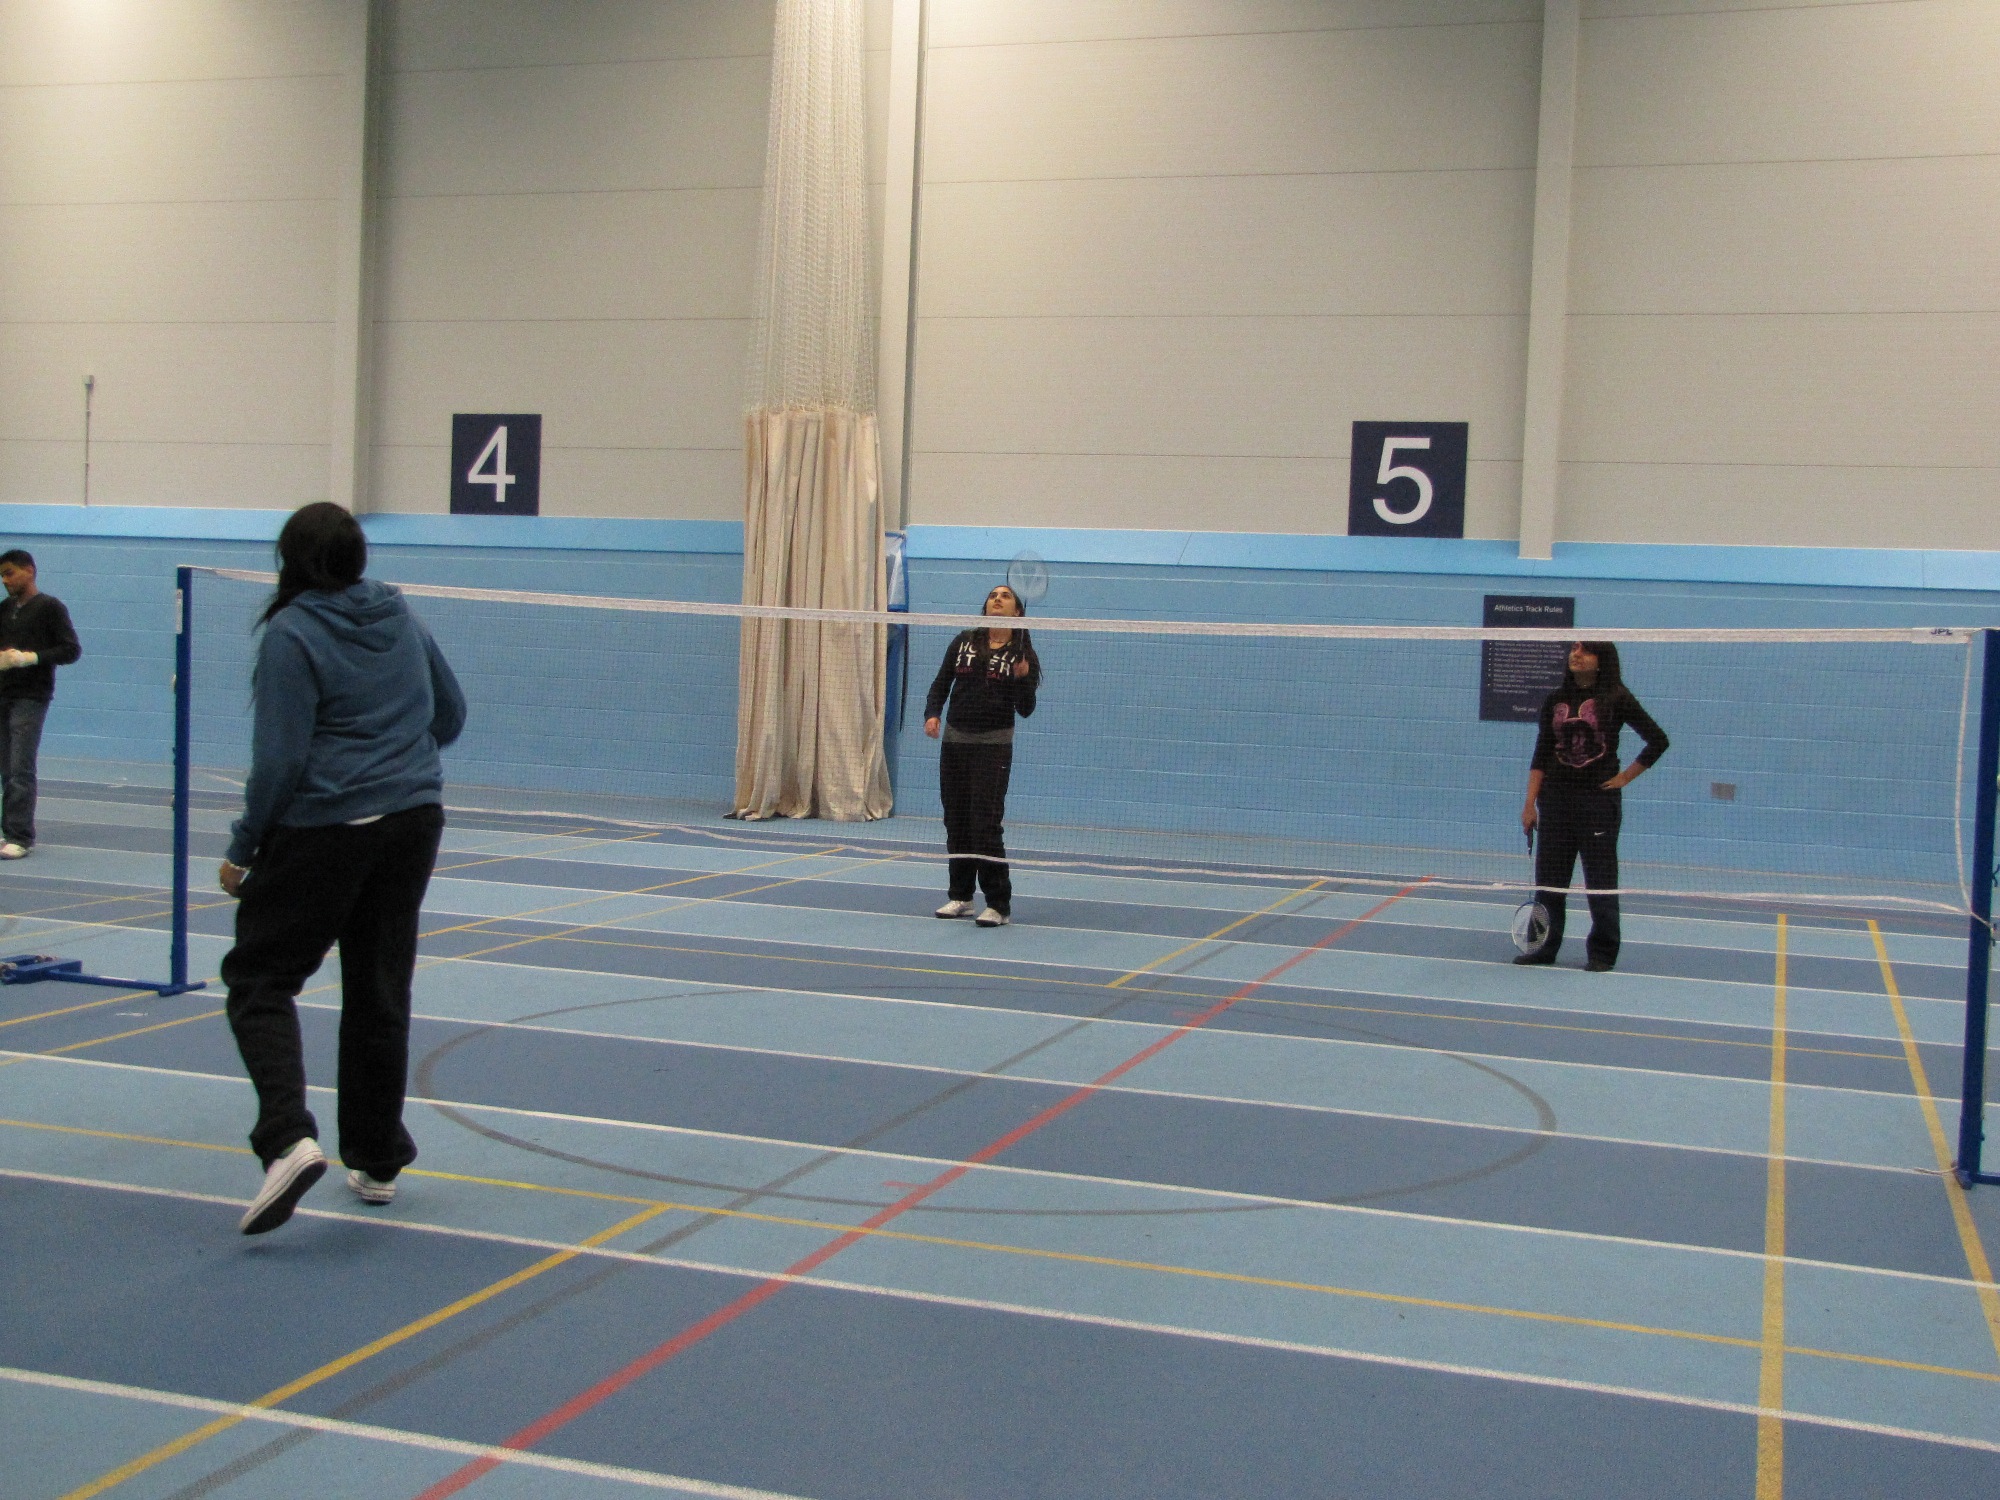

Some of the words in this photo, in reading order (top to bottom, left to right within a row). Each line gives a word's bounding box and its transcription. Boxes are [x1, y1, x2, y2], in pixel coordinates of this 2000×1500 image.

[467, 426, 516, 502] 4
[1372, 437, 1433, 524] 5
[1494, 604, 1523, 612] Athletics
[1525, 605, 1542, 613] Track
[1544, 605, 1563, 613] Rules
